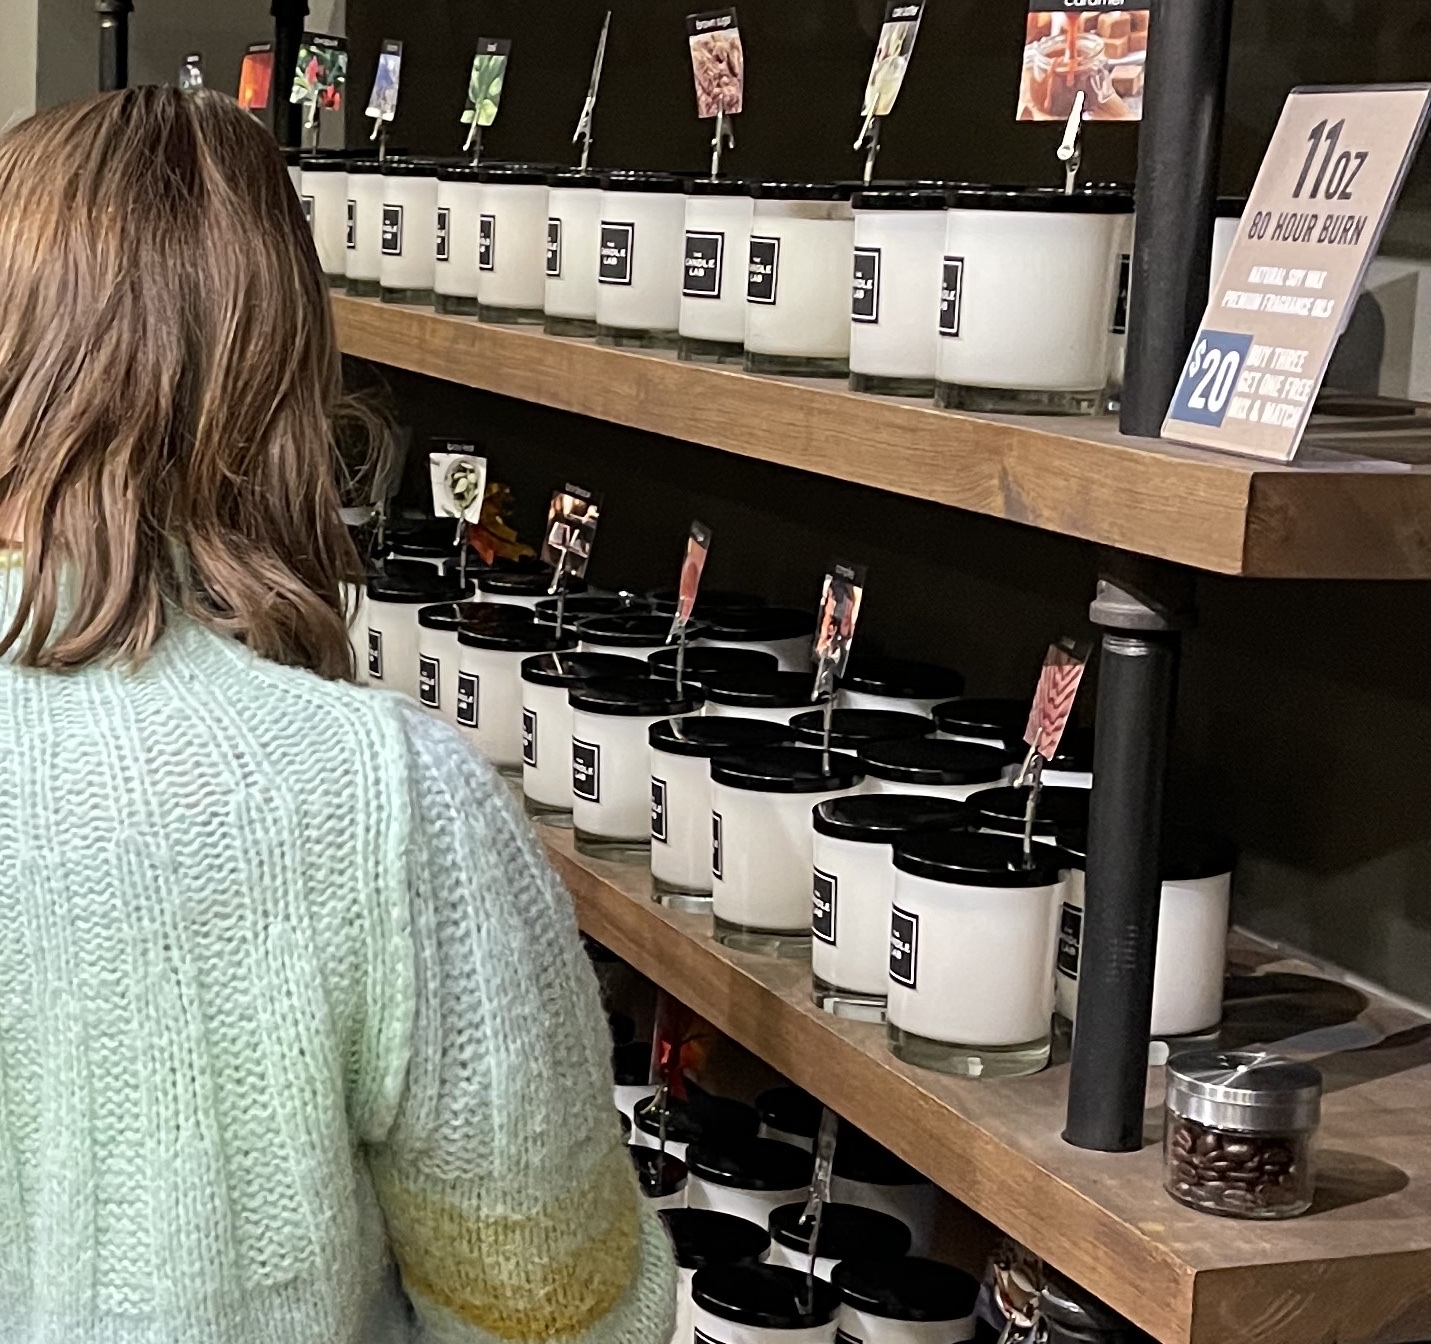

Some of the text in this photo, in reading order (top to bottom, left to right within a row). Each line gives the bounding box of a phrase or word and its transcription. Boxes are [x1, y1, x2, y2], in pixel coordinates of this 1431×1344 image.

[1248, 210, 1368, 246] 80 HOUR BURN
[1285, 268, 1308, 287] SOY
[1246, 344, 1309, 373] BUY THREE
[1187, 338, 1240, 413] $20
[1236, 370, 1315, 403] GET ONE FREE
[1249, 399, 1261, 422] &
[1260, 401, 1304, 429] MATCH
